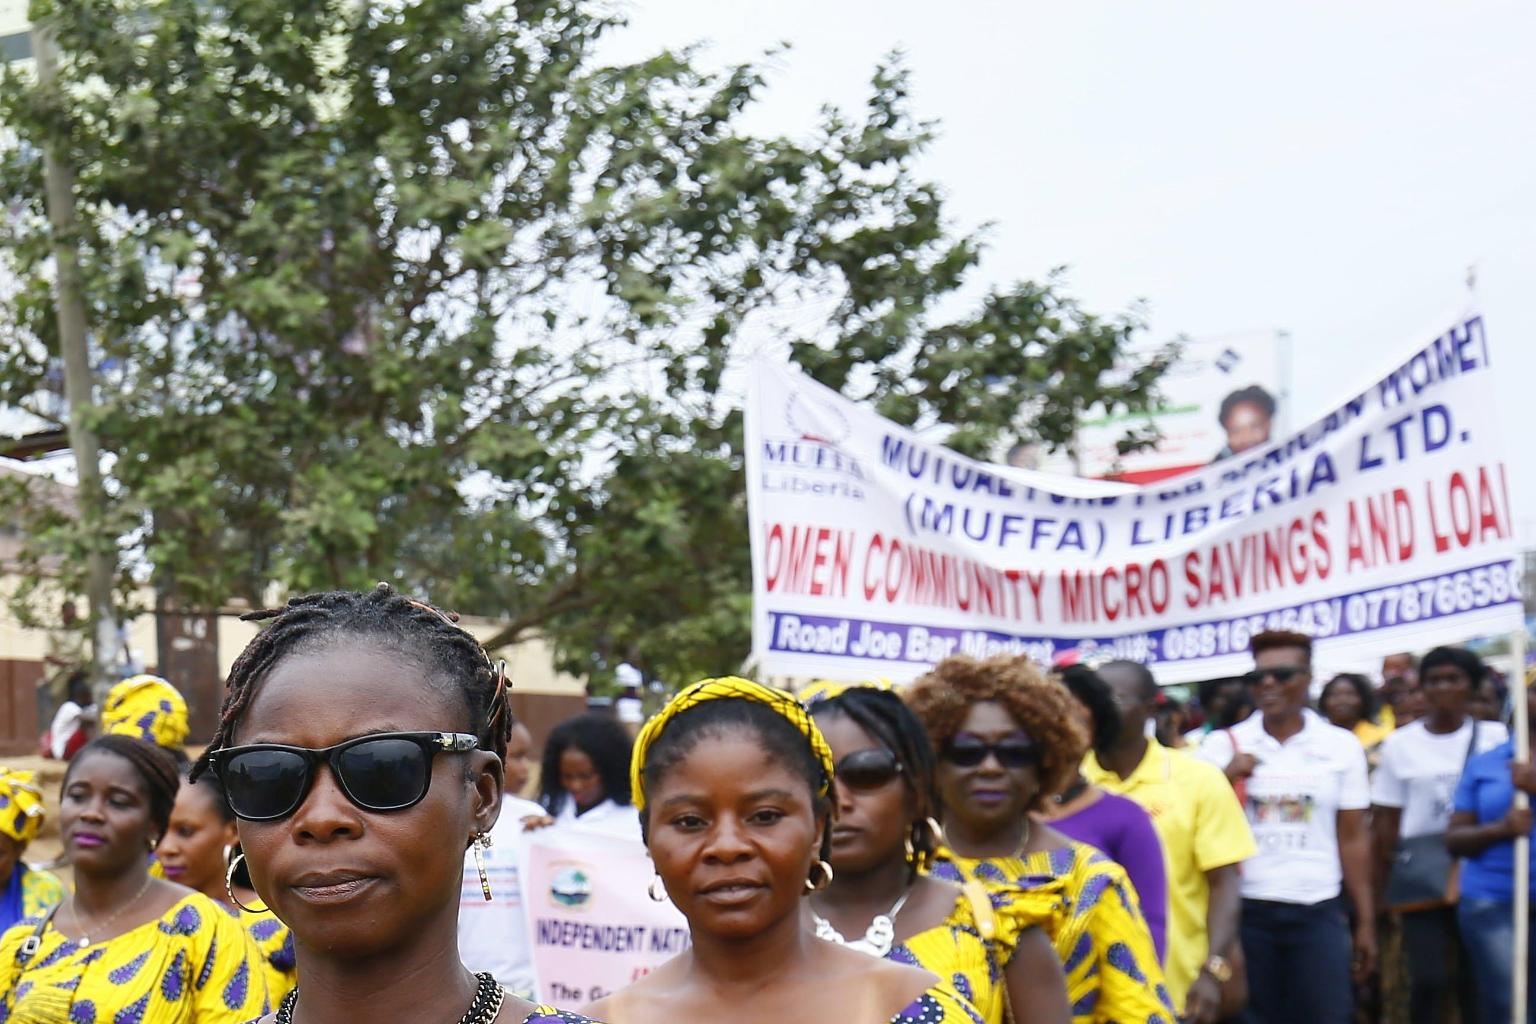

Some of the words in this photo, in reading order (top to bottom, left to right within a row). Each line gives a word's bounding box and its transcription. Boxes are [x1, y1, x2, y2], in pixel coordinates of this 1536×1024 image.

[905, 491, 1105, 561] (MUFFA)
[1131, 451, 1337, 546] LIBERIA
[1358, 404, 1470, 471] LTD.
[863, 533, 1046, 623] COMMUNITY
[1059, 558, 1171, 623] MICRO
[1186, 510, 1332, 608] SAVINGS
[1347, 487, 1415, 574] AND
[777, 613, 850, 653] Road
[850, 622, 903, 660] Joe
[905, 626, 959, 664] Bar
[537, 918, 646, 952] INDEPENDENT
[550, 982, 583, 1001] The
